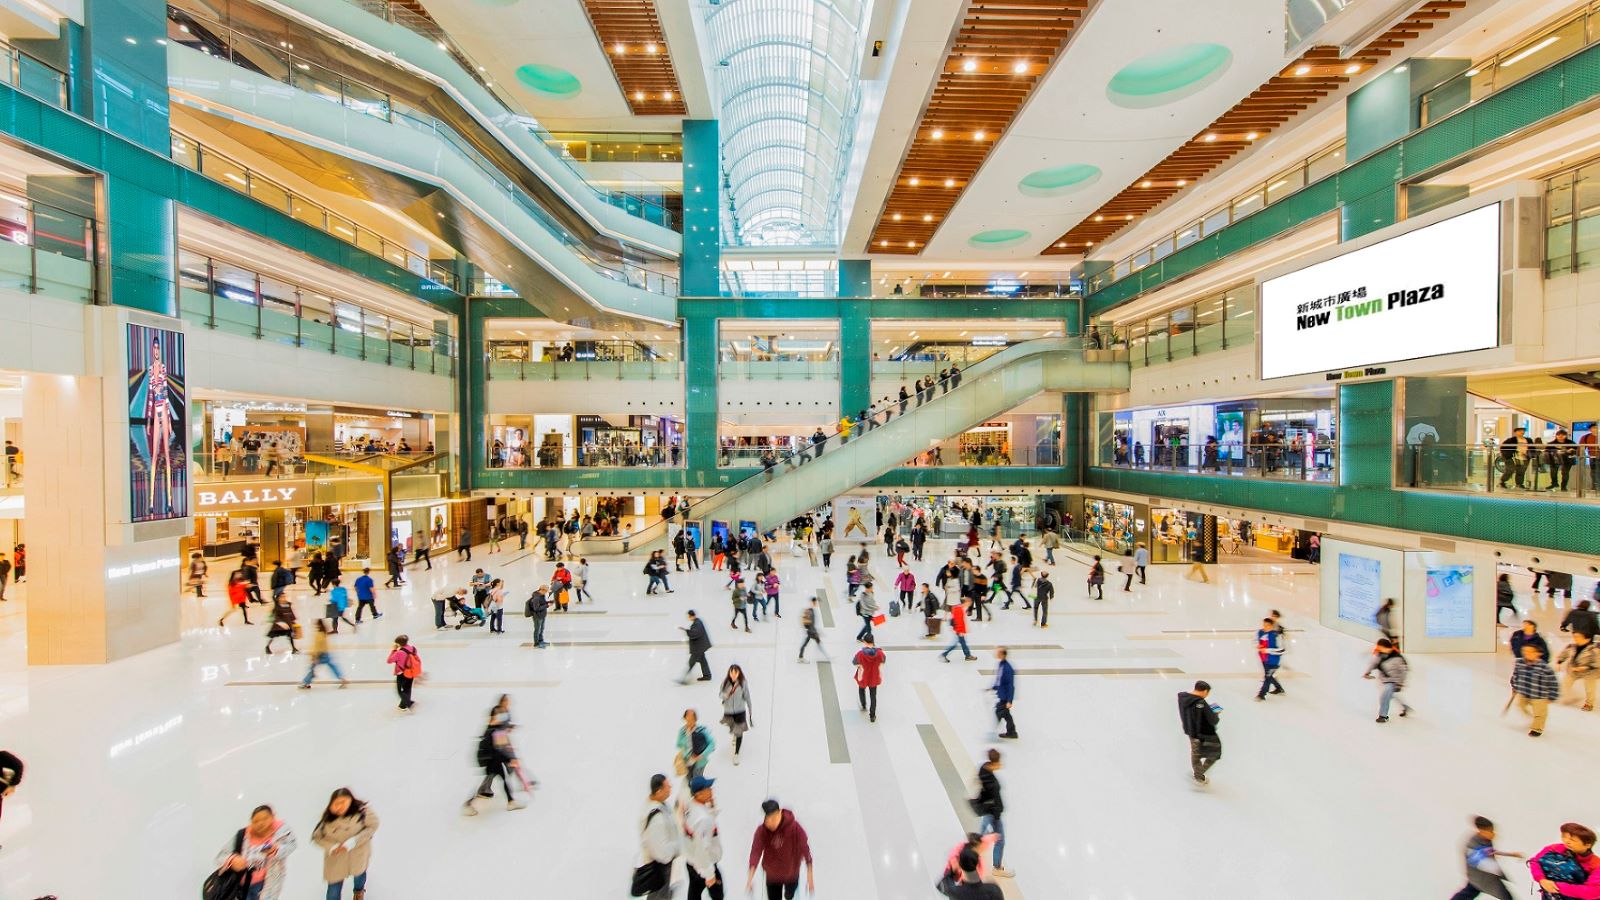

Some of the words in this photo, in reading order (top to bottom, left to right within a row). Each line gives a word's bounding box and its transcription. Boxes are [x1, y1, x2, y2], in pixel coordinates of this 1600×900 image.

[1296, 286, 1368, 314] 新城市廣場
[1296, 311, 1331, 331] New
[1335, 298, 1383, 322] Town
[1387, 283, 1445, 310] Plaza
[1344, 371, 1364, 379] Town
[1365, 368, 1386, 376] Plaza
[198, 487, 297, 506] BALLY
